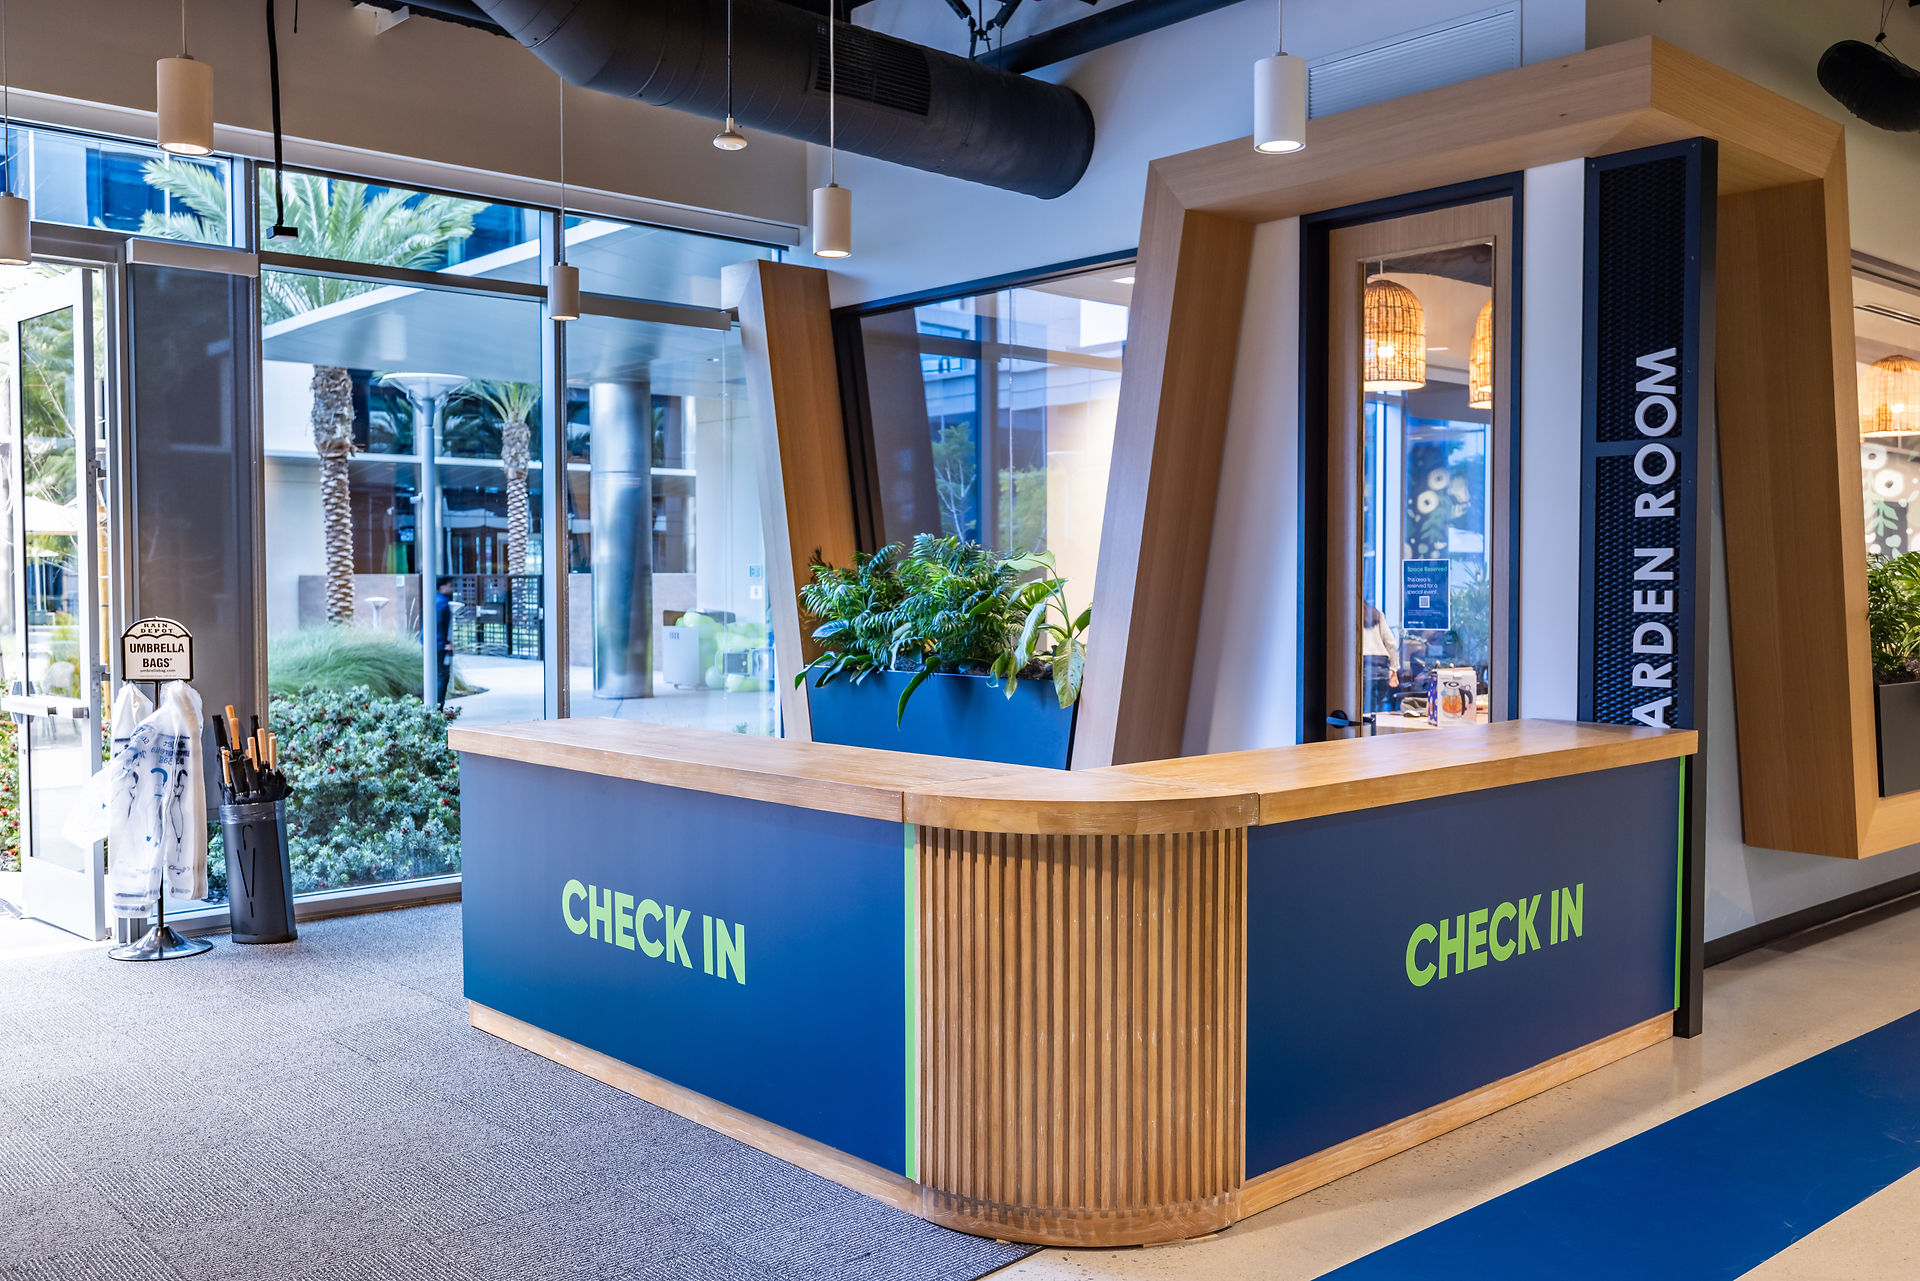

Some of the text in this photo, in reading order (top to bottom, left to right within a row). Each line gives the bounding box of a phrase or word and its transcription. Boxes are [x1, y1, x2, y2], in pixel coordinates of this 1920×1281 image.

[1631, 347, 1678, 729] ARDEN ROOM
[129, 643, 185, 653] UMBRELLA
[561, 879, 746, 985] CHECK IN
[1405, 882, 1584, 987] CHECK IN
